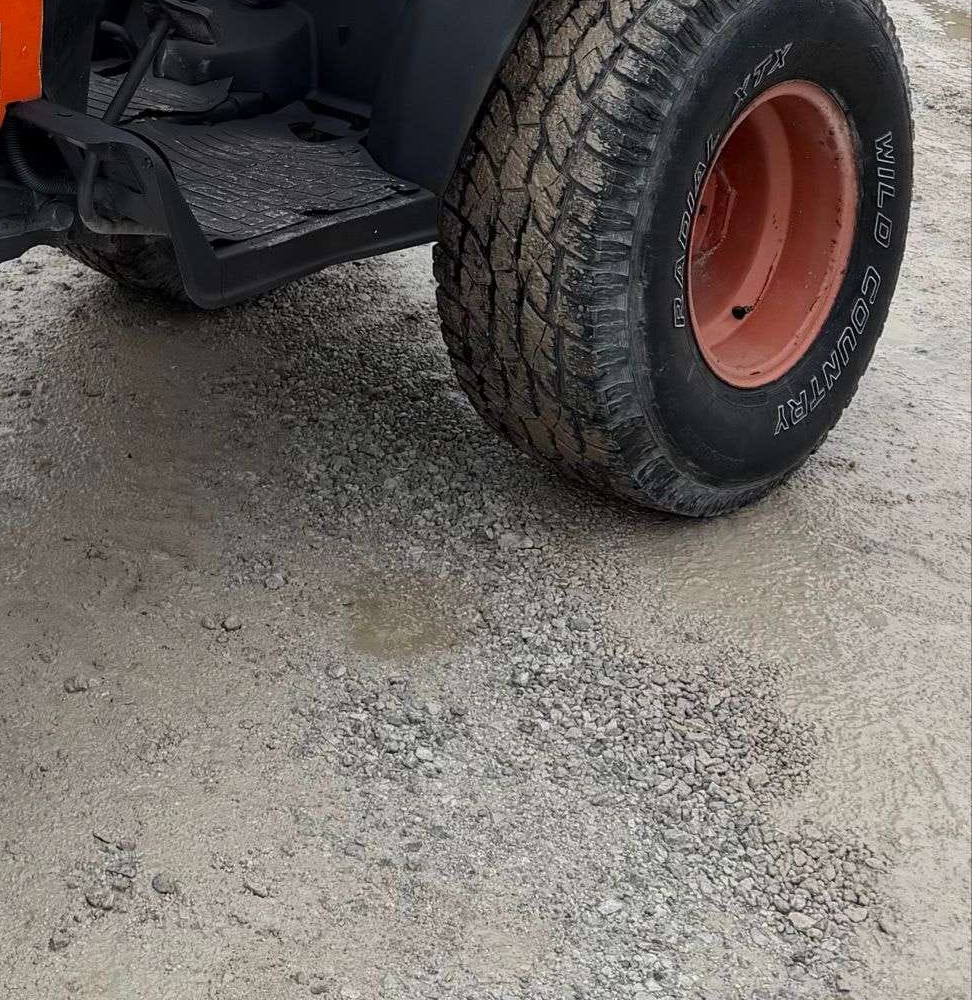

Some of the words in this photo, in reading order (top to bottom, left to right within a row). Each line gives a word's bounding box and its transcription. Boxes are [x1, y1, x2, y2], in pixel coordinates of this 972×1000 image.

[673, 132, 720, 328] RADIAL
[874, 130, 896, 249] WILD
[773, 265, 881, 435] COUNTRY
